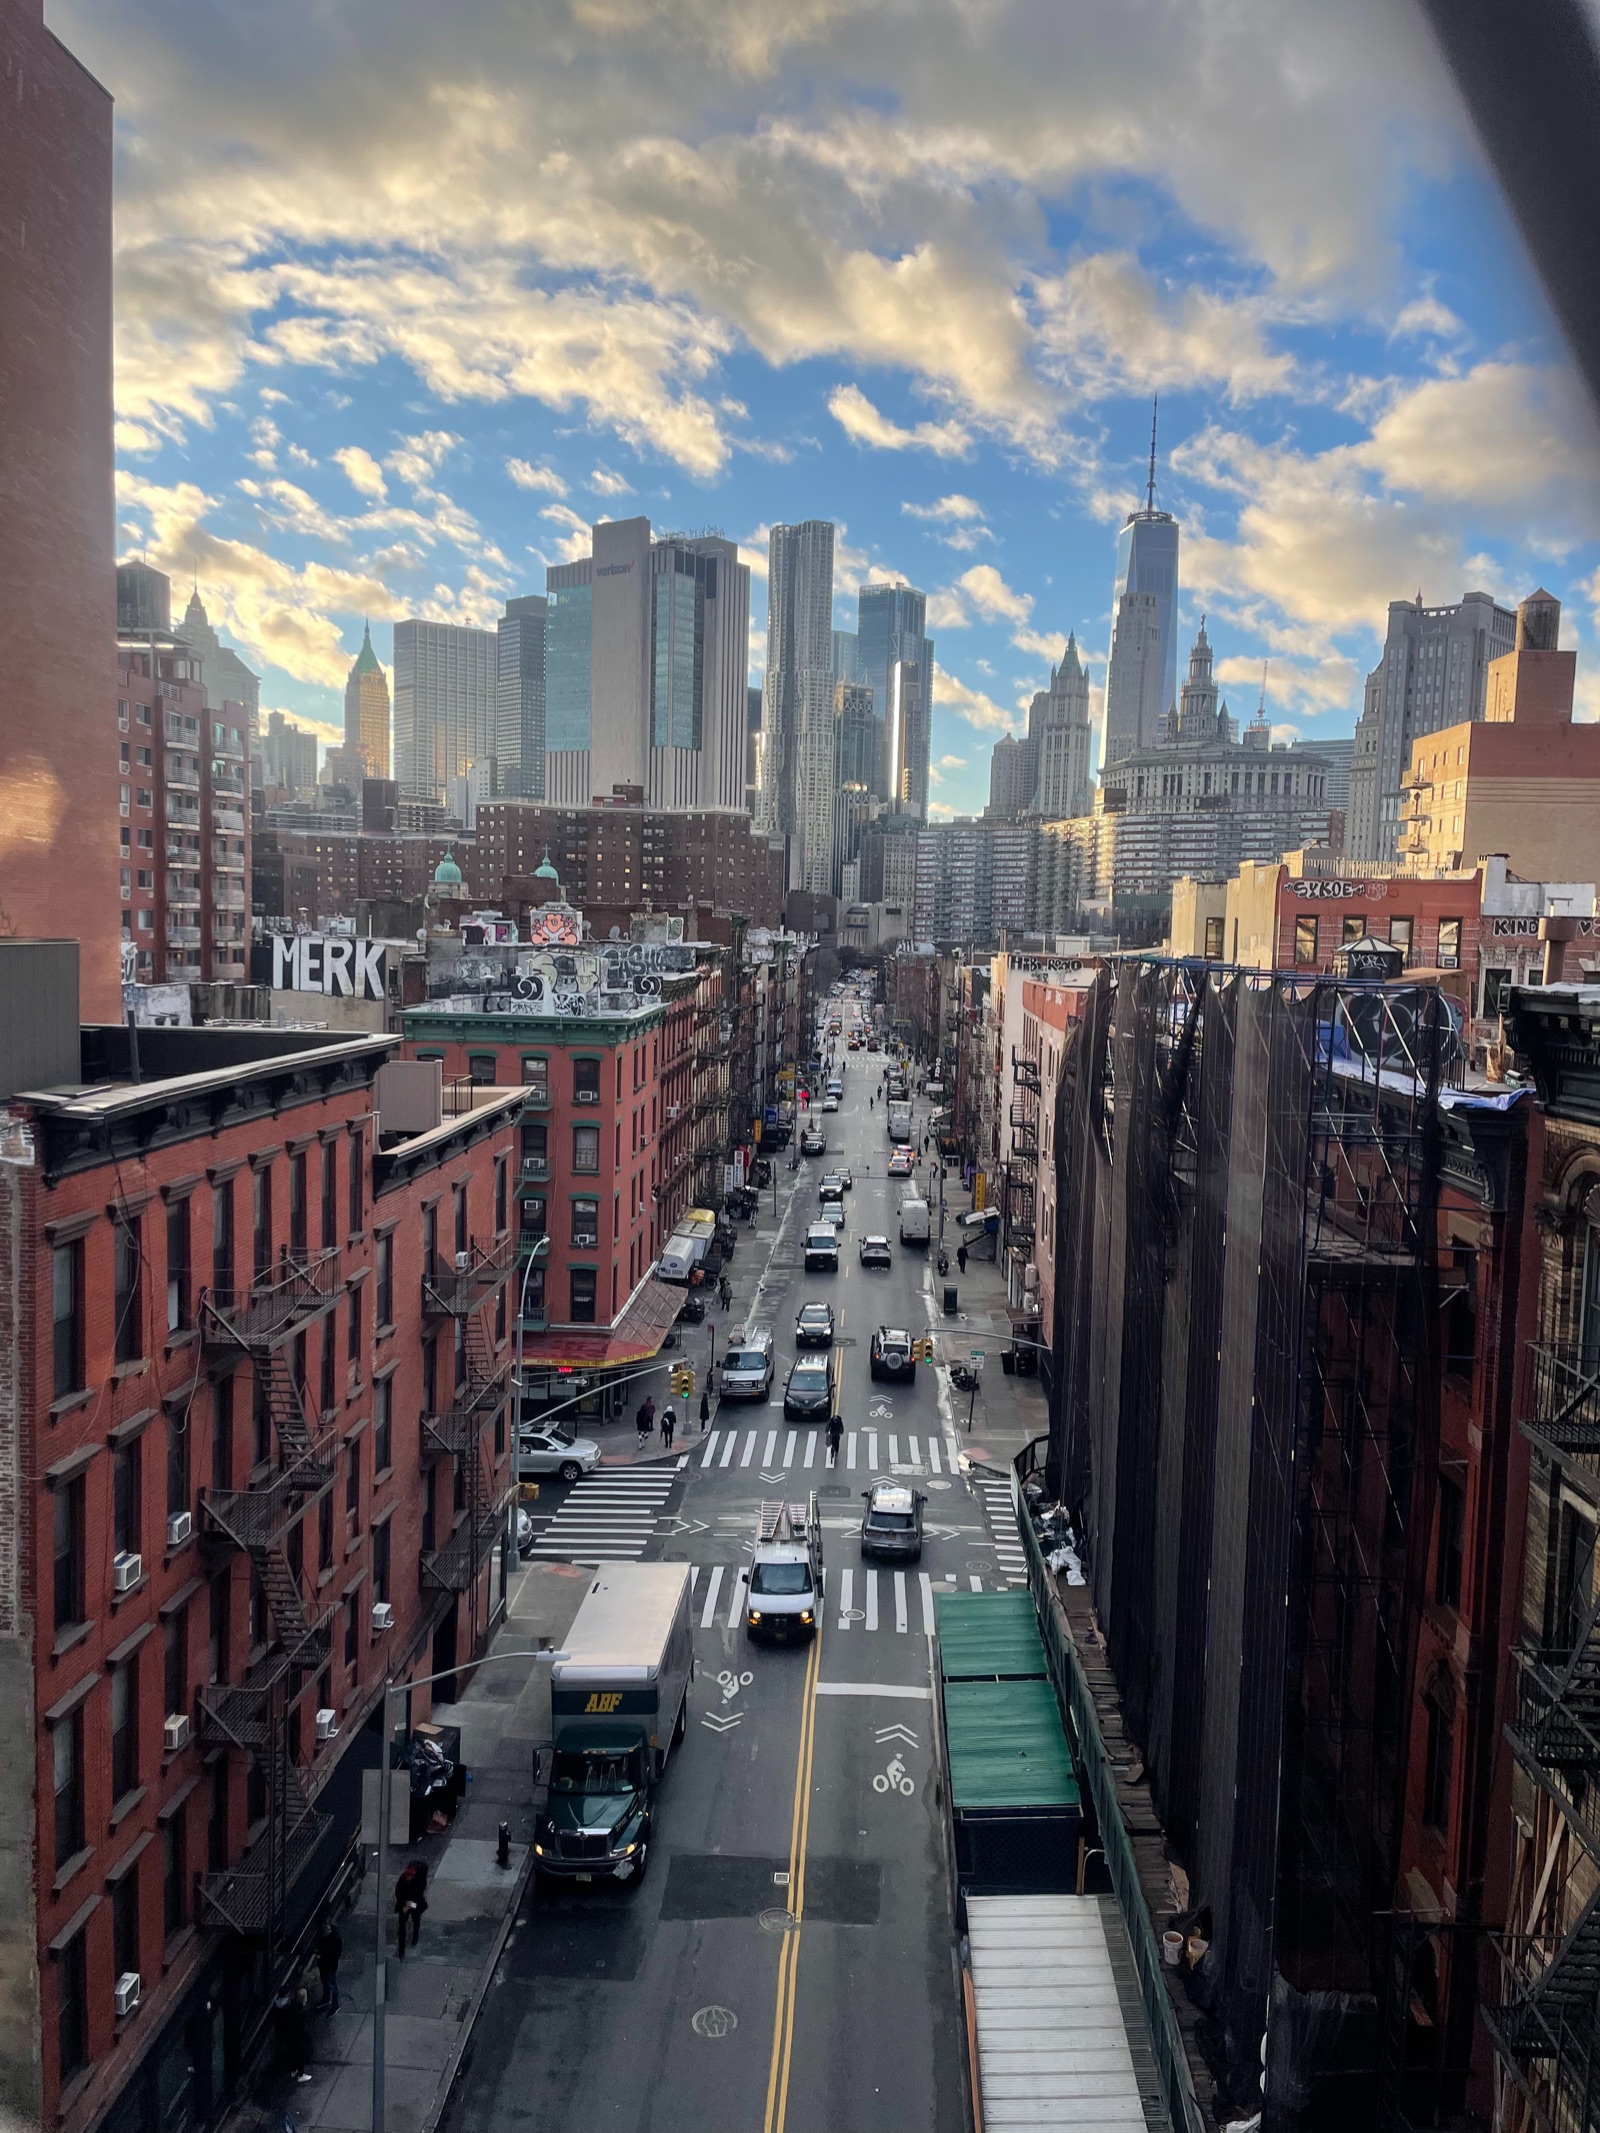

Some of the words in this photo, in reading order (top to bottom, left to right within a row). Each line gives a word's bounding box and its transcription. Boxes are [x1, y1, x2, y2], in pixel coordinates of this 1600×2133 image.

[596, 563, 631, 577] verizon
[272, 936, 386, 1001] MERK
[584, 1693, 623, 1712] ABF
